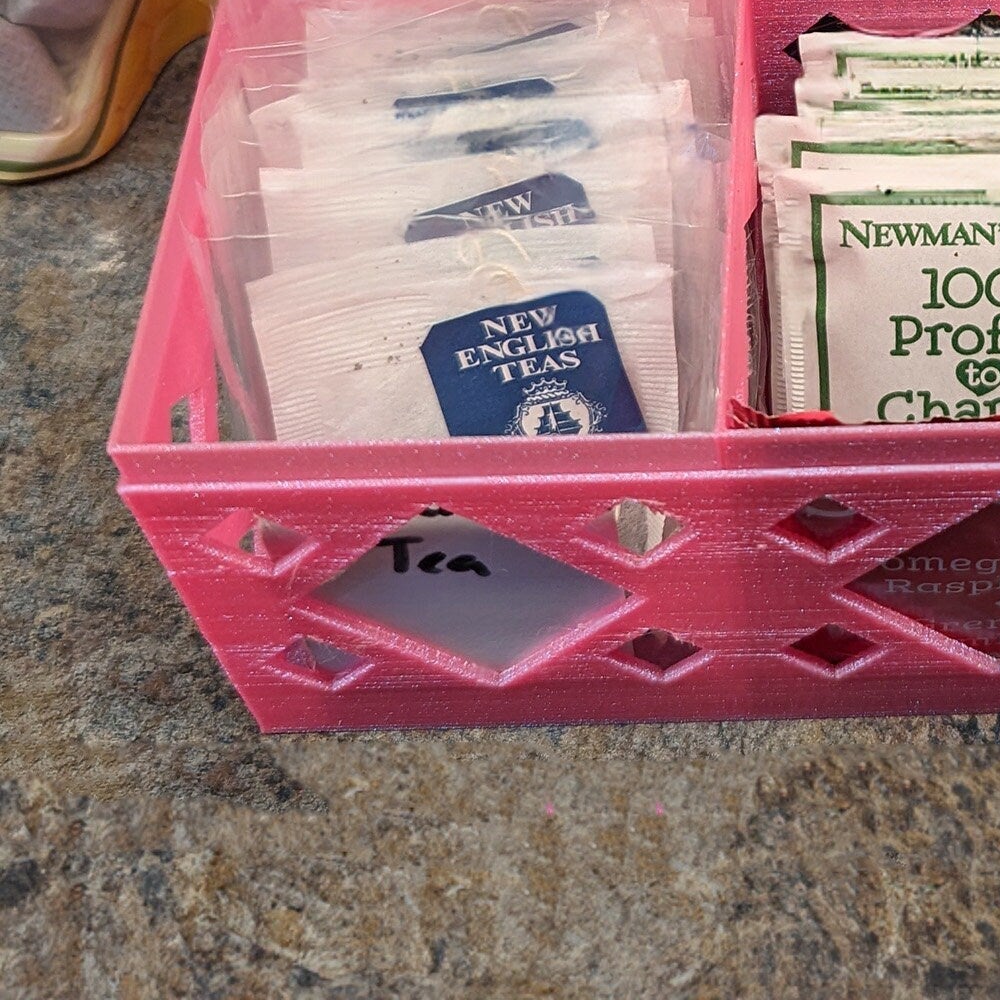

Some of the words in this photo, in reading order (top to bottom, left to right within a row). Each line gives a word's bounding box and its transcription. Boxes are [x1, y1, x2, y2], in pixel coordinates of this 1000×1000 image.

[480, 304, 558, 340] NEW
[454, 322, 603, 371] ENGLISH
[492, 349, 582, 384] TEAS
[376, 535, 491, 577] Tea
